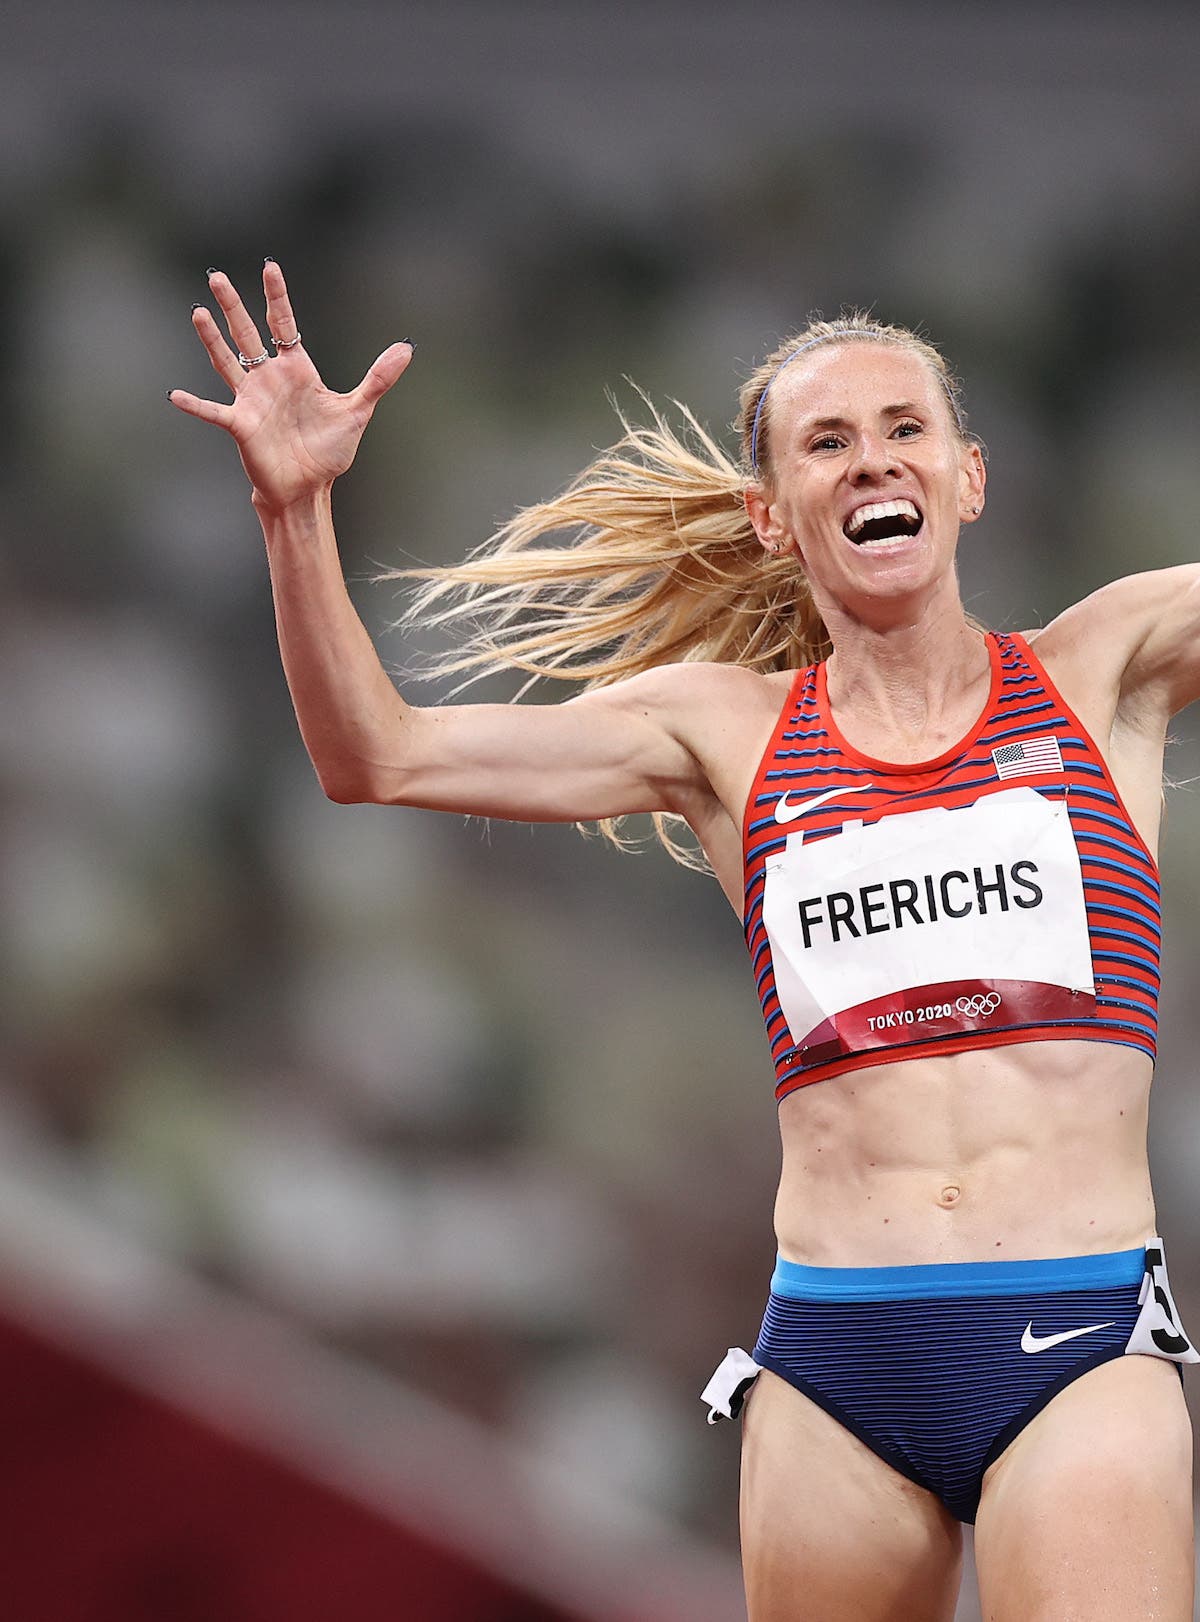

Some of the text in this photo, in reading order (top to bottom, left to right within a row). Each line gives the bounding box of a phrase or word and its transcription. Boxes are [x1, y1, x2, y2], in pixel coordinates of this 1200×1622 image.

[799, 861, 1043, 948] FRERICHS
[867, 1003, 952, 1032] TOKYO 2020
